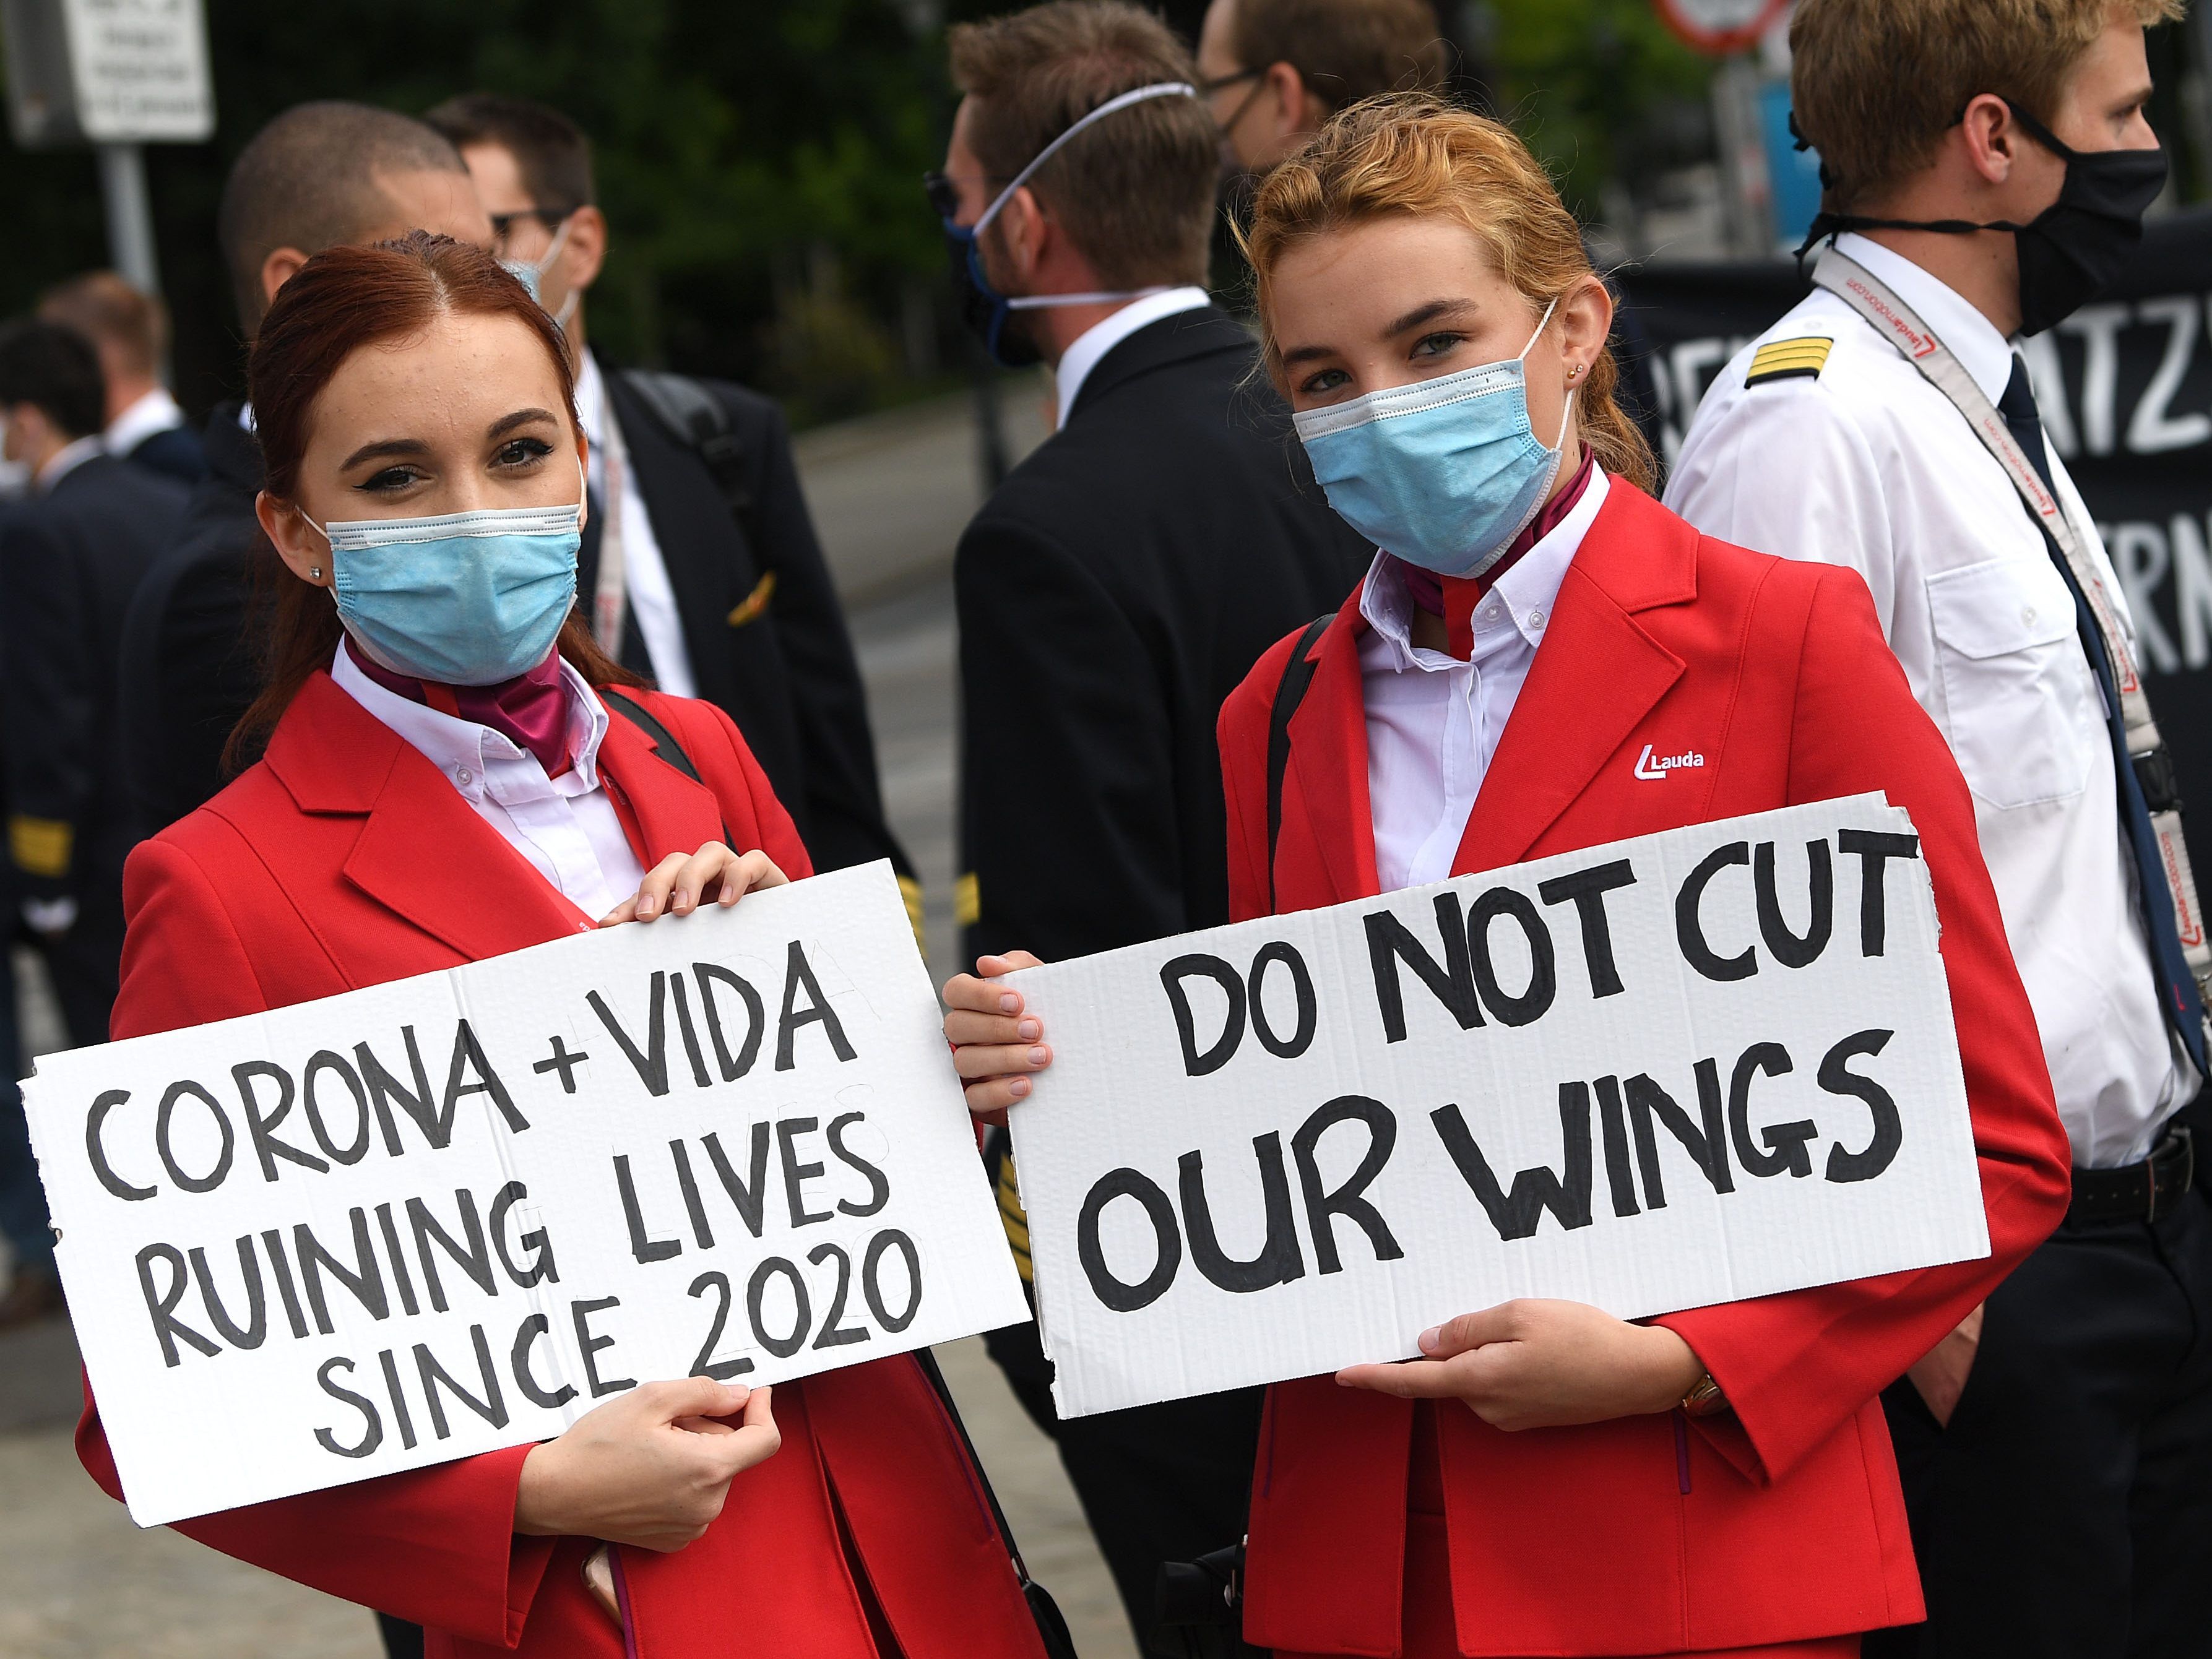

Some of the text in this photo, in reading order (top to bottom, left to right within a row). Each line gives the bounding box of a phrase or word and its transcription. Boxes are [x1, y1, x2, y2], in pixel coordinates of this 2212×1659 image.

[86, 940, 857, 1201] CORONA + VIDA
[1159, 829, 1917, 1076] DO NOT CUT
[136, 1111, 889, 1368] RUINING LIVES
[1078, 1029, 1902, 1312] OUR WINGS
[314, 1229, 922, 1458] SINCE 2020
